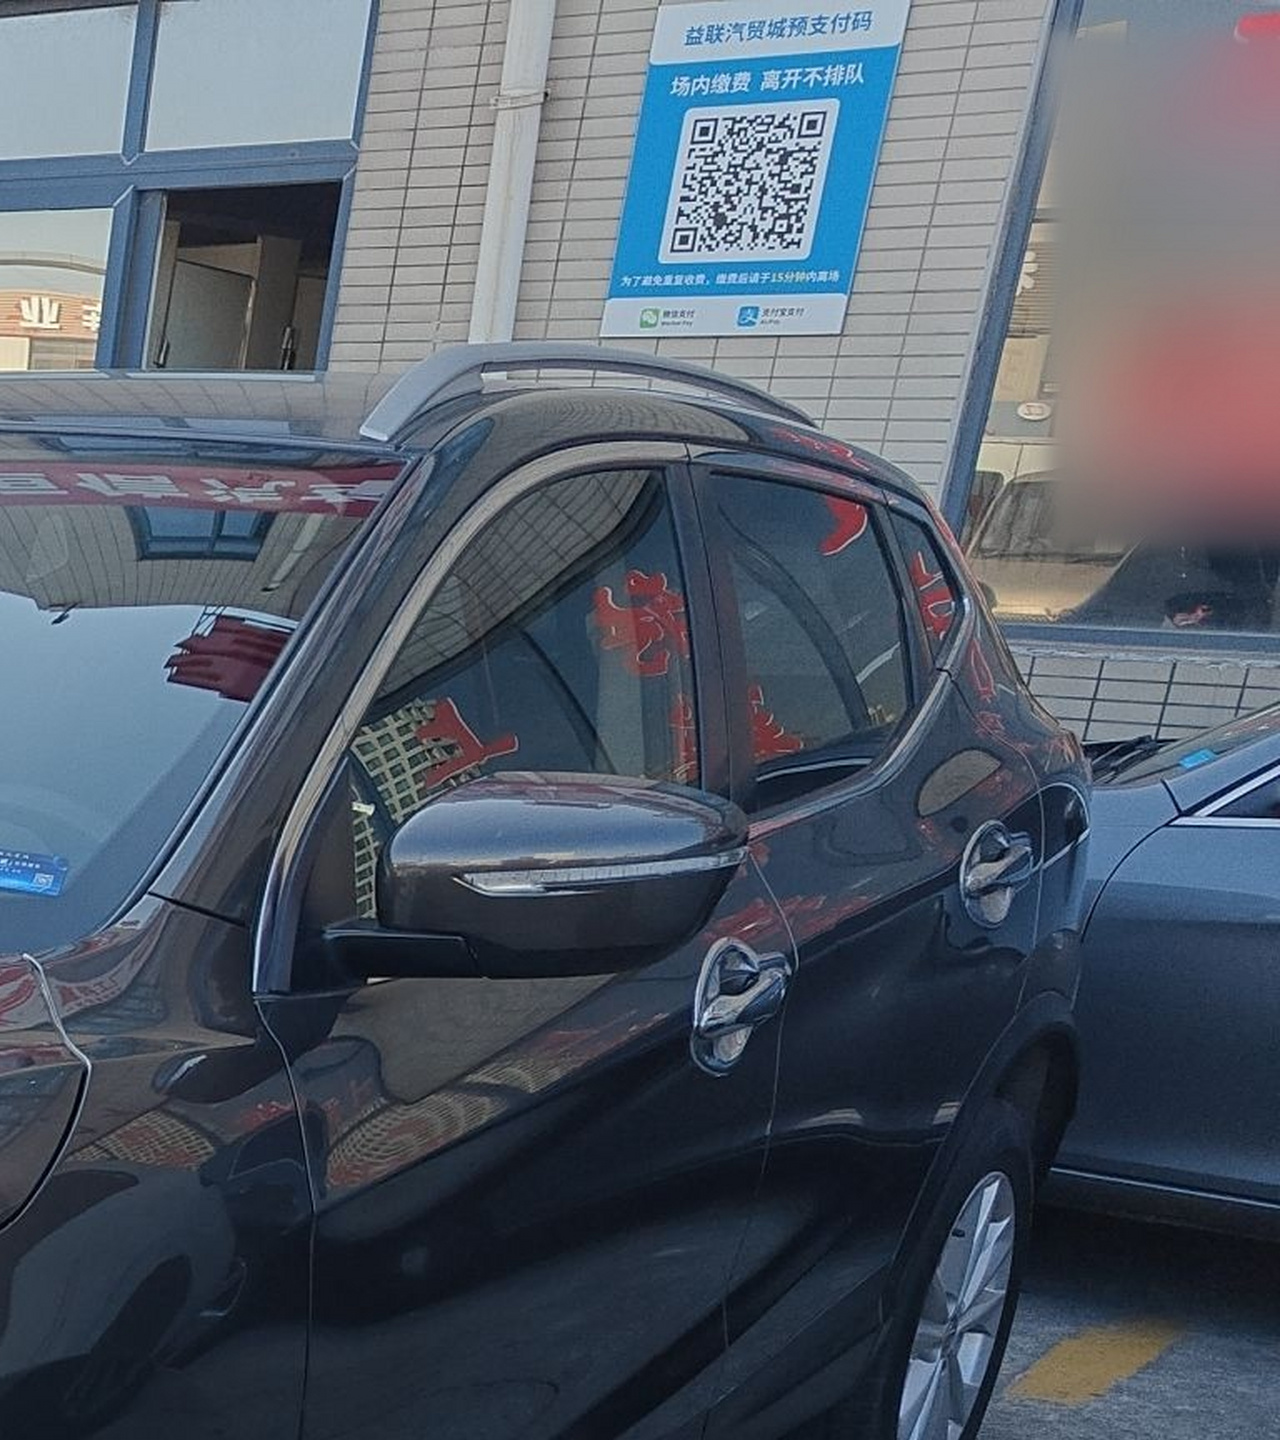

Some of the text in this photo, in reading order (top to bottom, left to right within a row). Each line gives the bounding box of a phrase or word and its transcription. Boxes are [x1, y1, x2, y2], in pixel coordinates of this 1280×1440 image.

[684, 10, 873, 46] 益联汽贸城预支付码
[670, 62, 865, 97] 场内缴费 离开不排队
